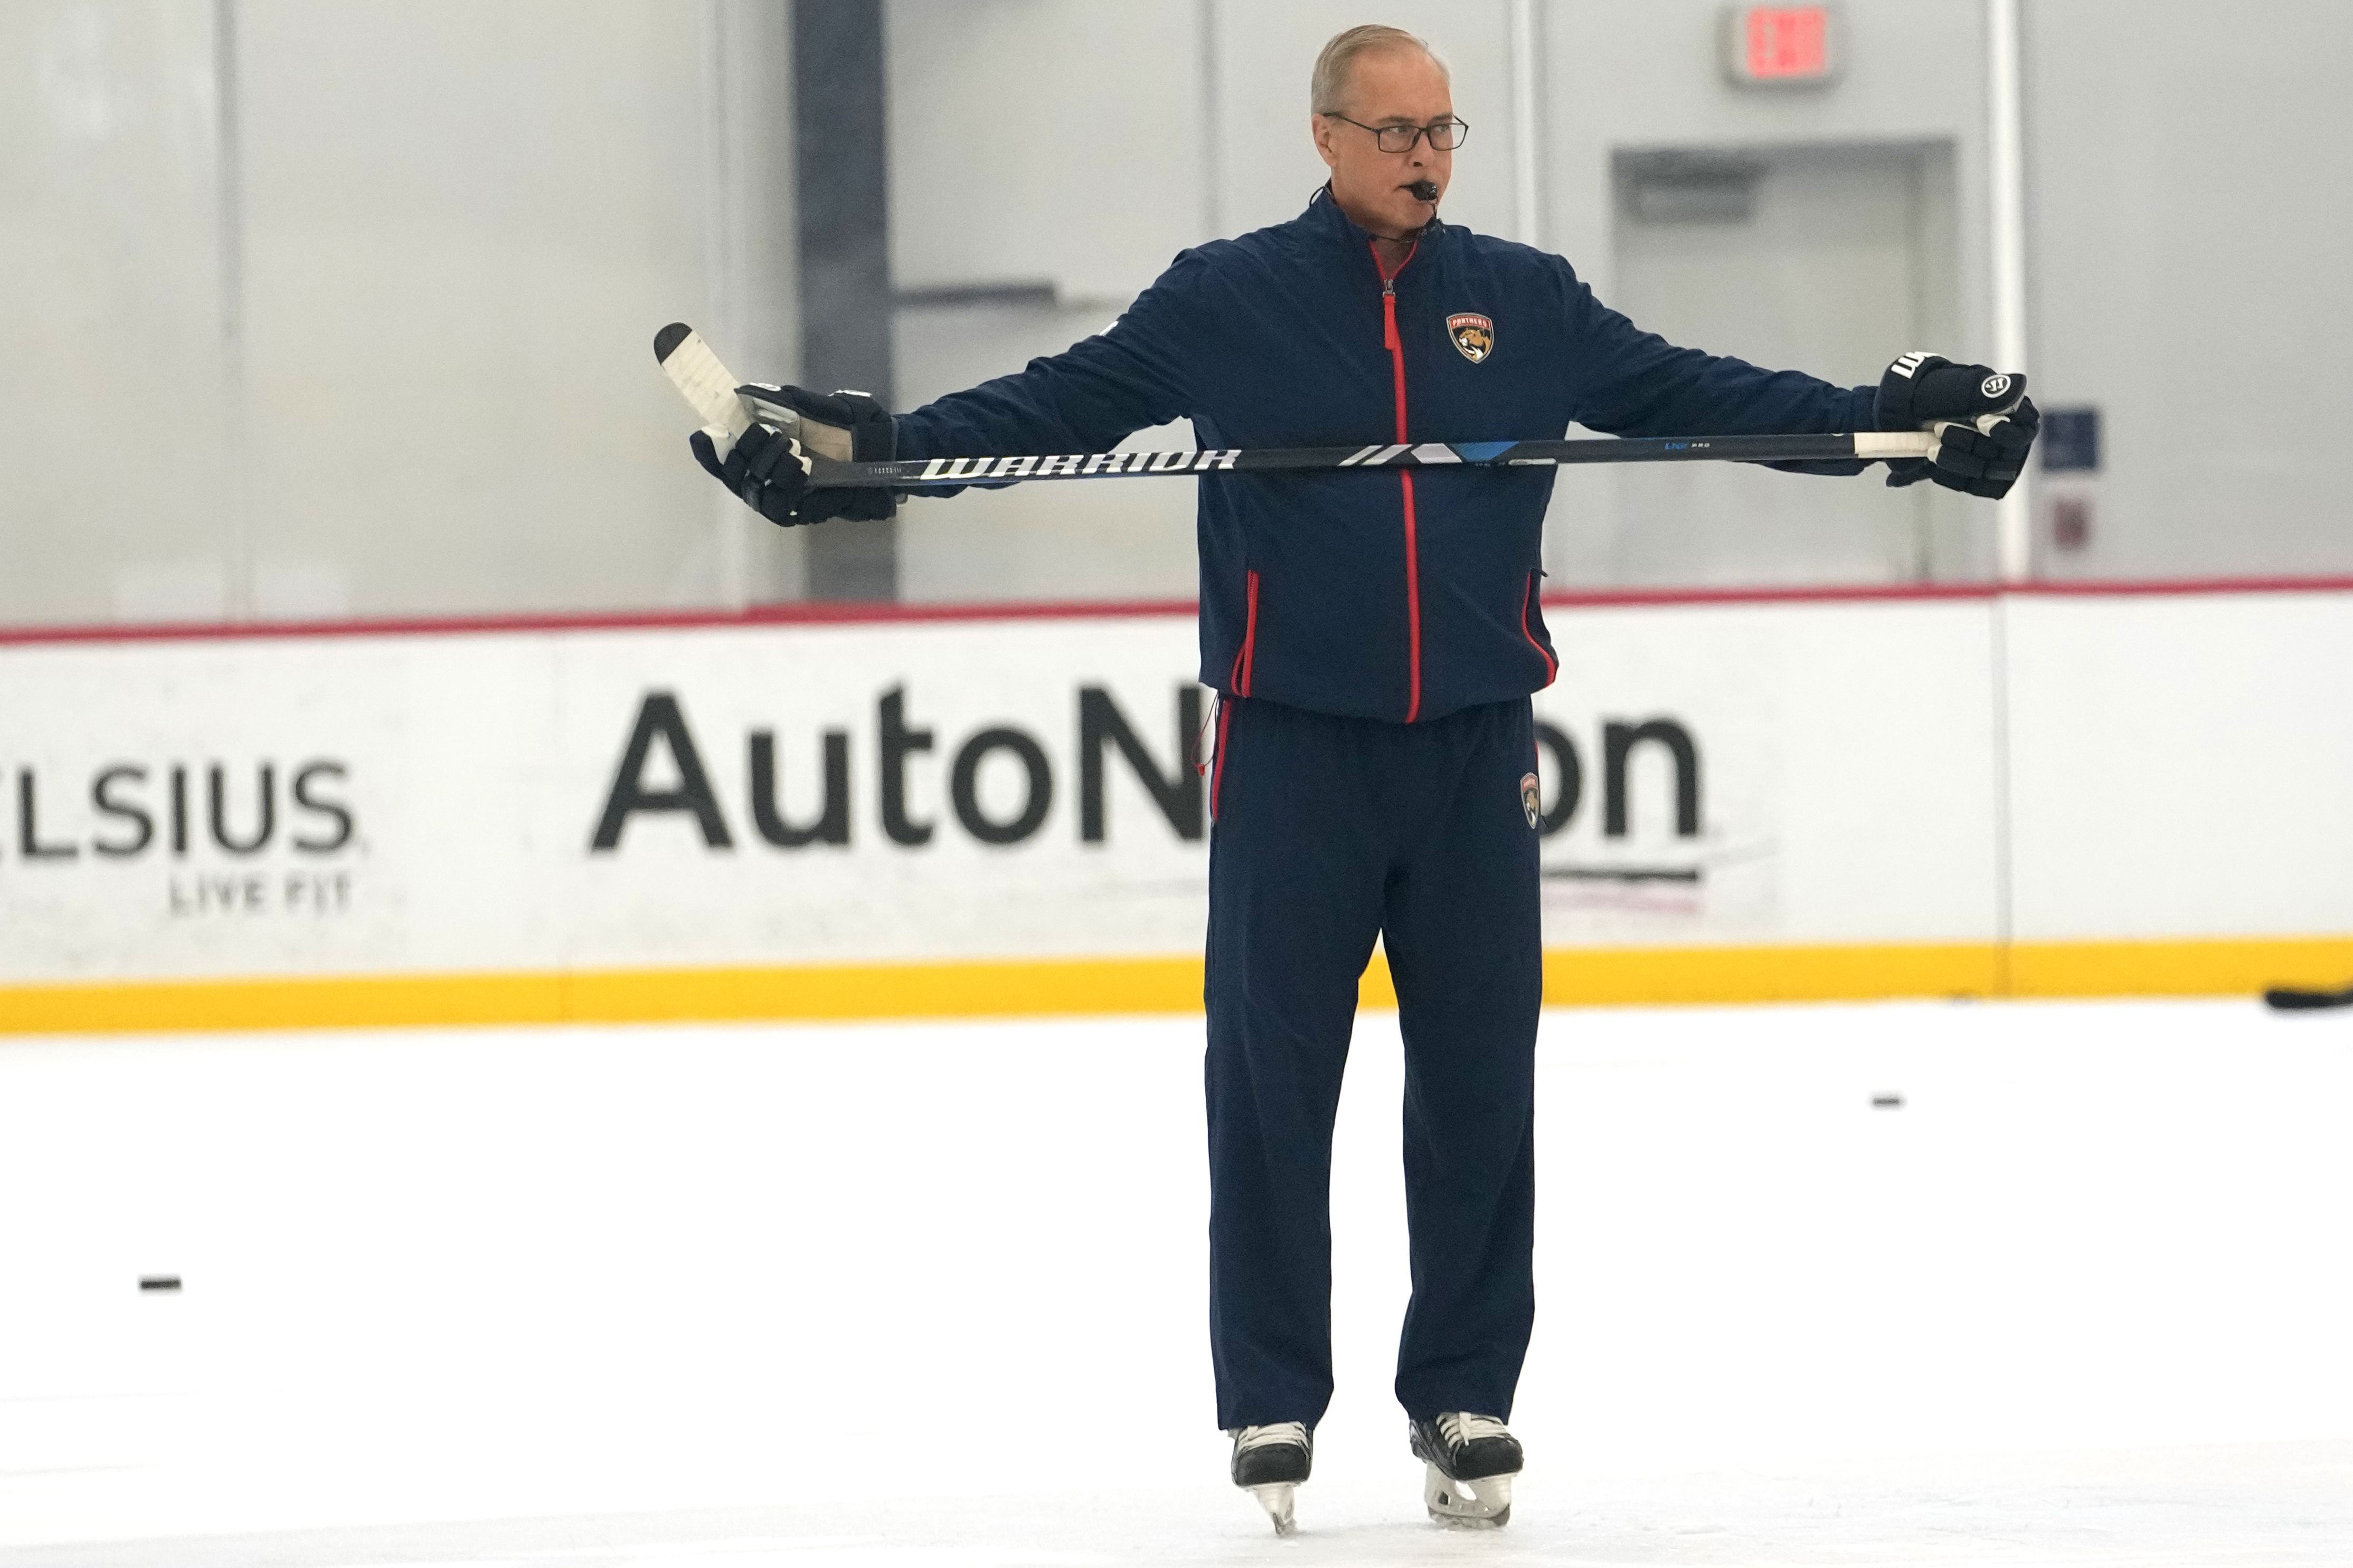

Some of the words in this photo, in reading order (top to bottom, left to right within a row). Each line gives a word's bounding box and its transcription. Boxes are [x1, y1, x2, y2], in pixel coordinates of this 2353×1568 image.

[1452, 317, 1487, 327] PANTHERS
[920, 449, 1242, 480] WARRIOR
[587, 682, 1698, 851] AutoNn
[0, 758, 355, 860] LSIUS
[170, 873, 266, 915] LIVE
[284, 870, 352, 913] FIT
